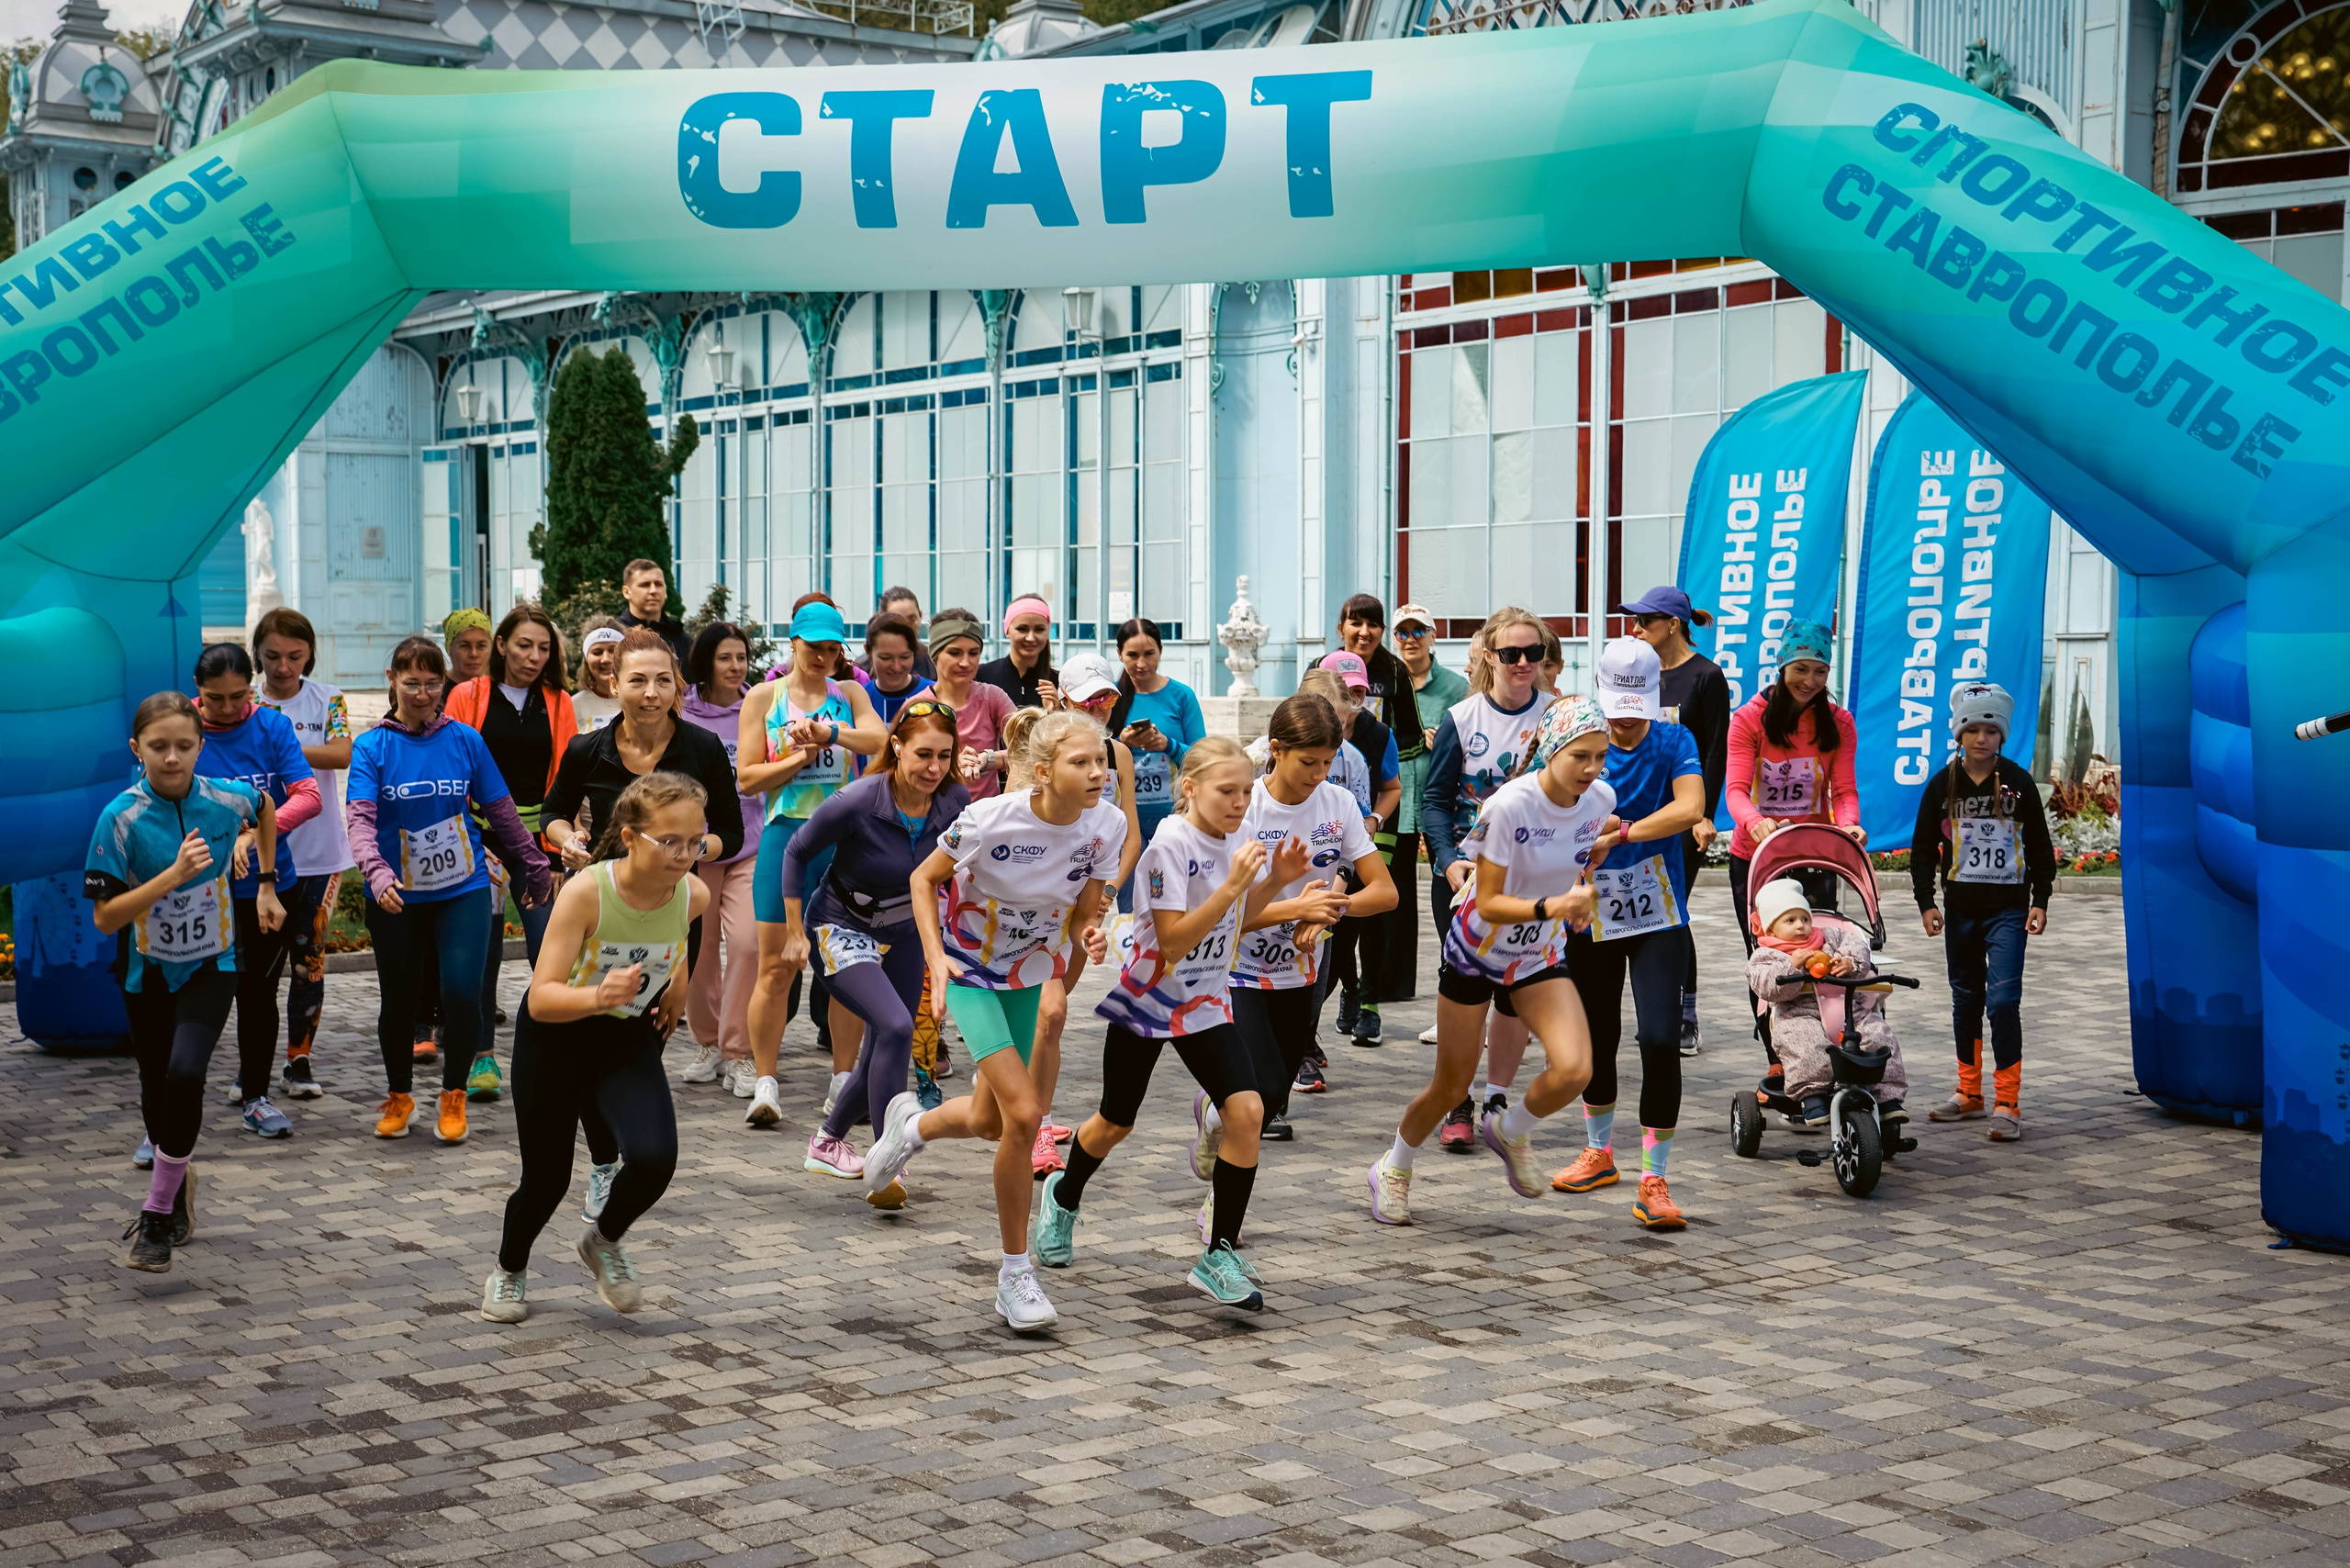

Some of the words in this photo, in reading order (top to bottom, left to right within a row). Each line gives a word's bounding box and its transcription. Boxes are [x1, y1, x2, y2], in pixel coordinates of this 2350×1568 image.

[677, 70, 1373, 229] СТАРТ
[1874, 103, 2350, 407] СПОРТИВНОЕ
[1823, 163, 2302, 481] СТАВРОПОЛЬЕ
[1613, 673, 1647, 684] ТРИАТЛОН
[1135, 774, 1162, 793] 239
[1766, 783, 1804, 801] 215
[1258, 829, 1289, 840] СКФУ
[1311, 836, 1343, 846] TRIATHLON
[1013, 845, 1048, 856] СКФУ
[1968, 846, 2006, 869] 318
[419, 848, 457, 877] 209
[1609, 893, 1653, 922] 212
[160, 915, 207, 945] 315
[1605, 921, 1651, 935] СТАВРОПОЛЬСКИЙ
[1651, 918, 1664, 927] КРАЙ
[1280, 964, 1293, 973] КРАЙ
